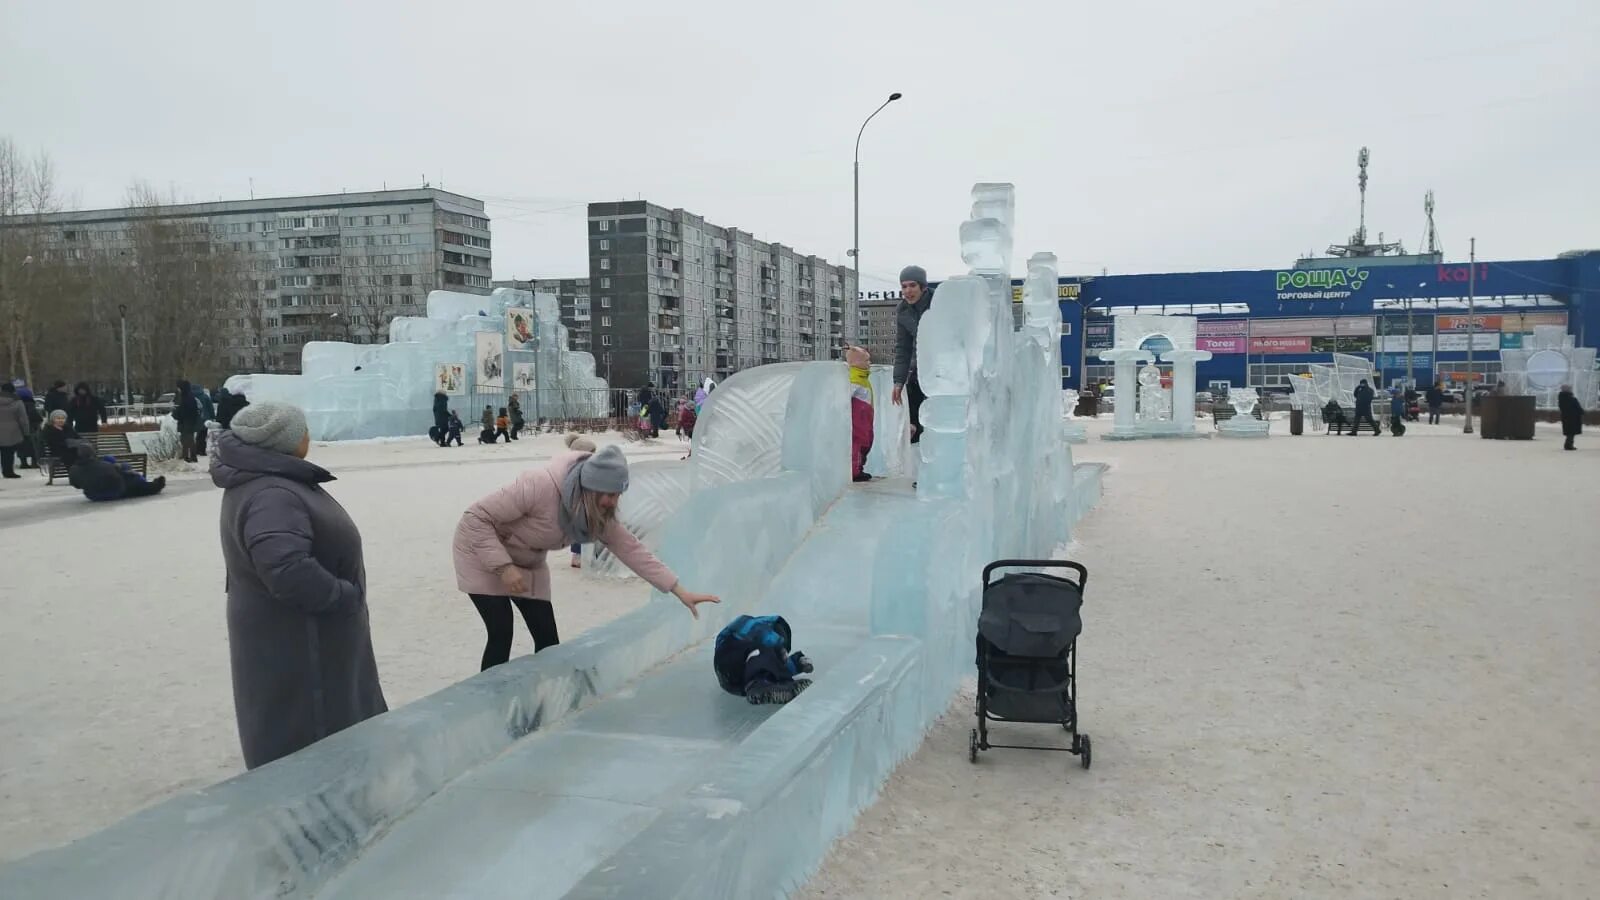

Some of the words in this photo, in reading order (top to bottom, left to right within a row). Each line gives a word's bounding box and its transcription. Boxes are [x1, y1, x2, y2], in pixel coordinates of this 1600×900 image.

[1437, 263, 1488, 281] kai
[1276, 269, 1347, 290] РОЩА
[1277, 291, 1322, 300] ТОРГОВЫЙ
[1323, 291, 1351, 299] ЦЕНТР
[1205, 340, 1236, 348] Torex
